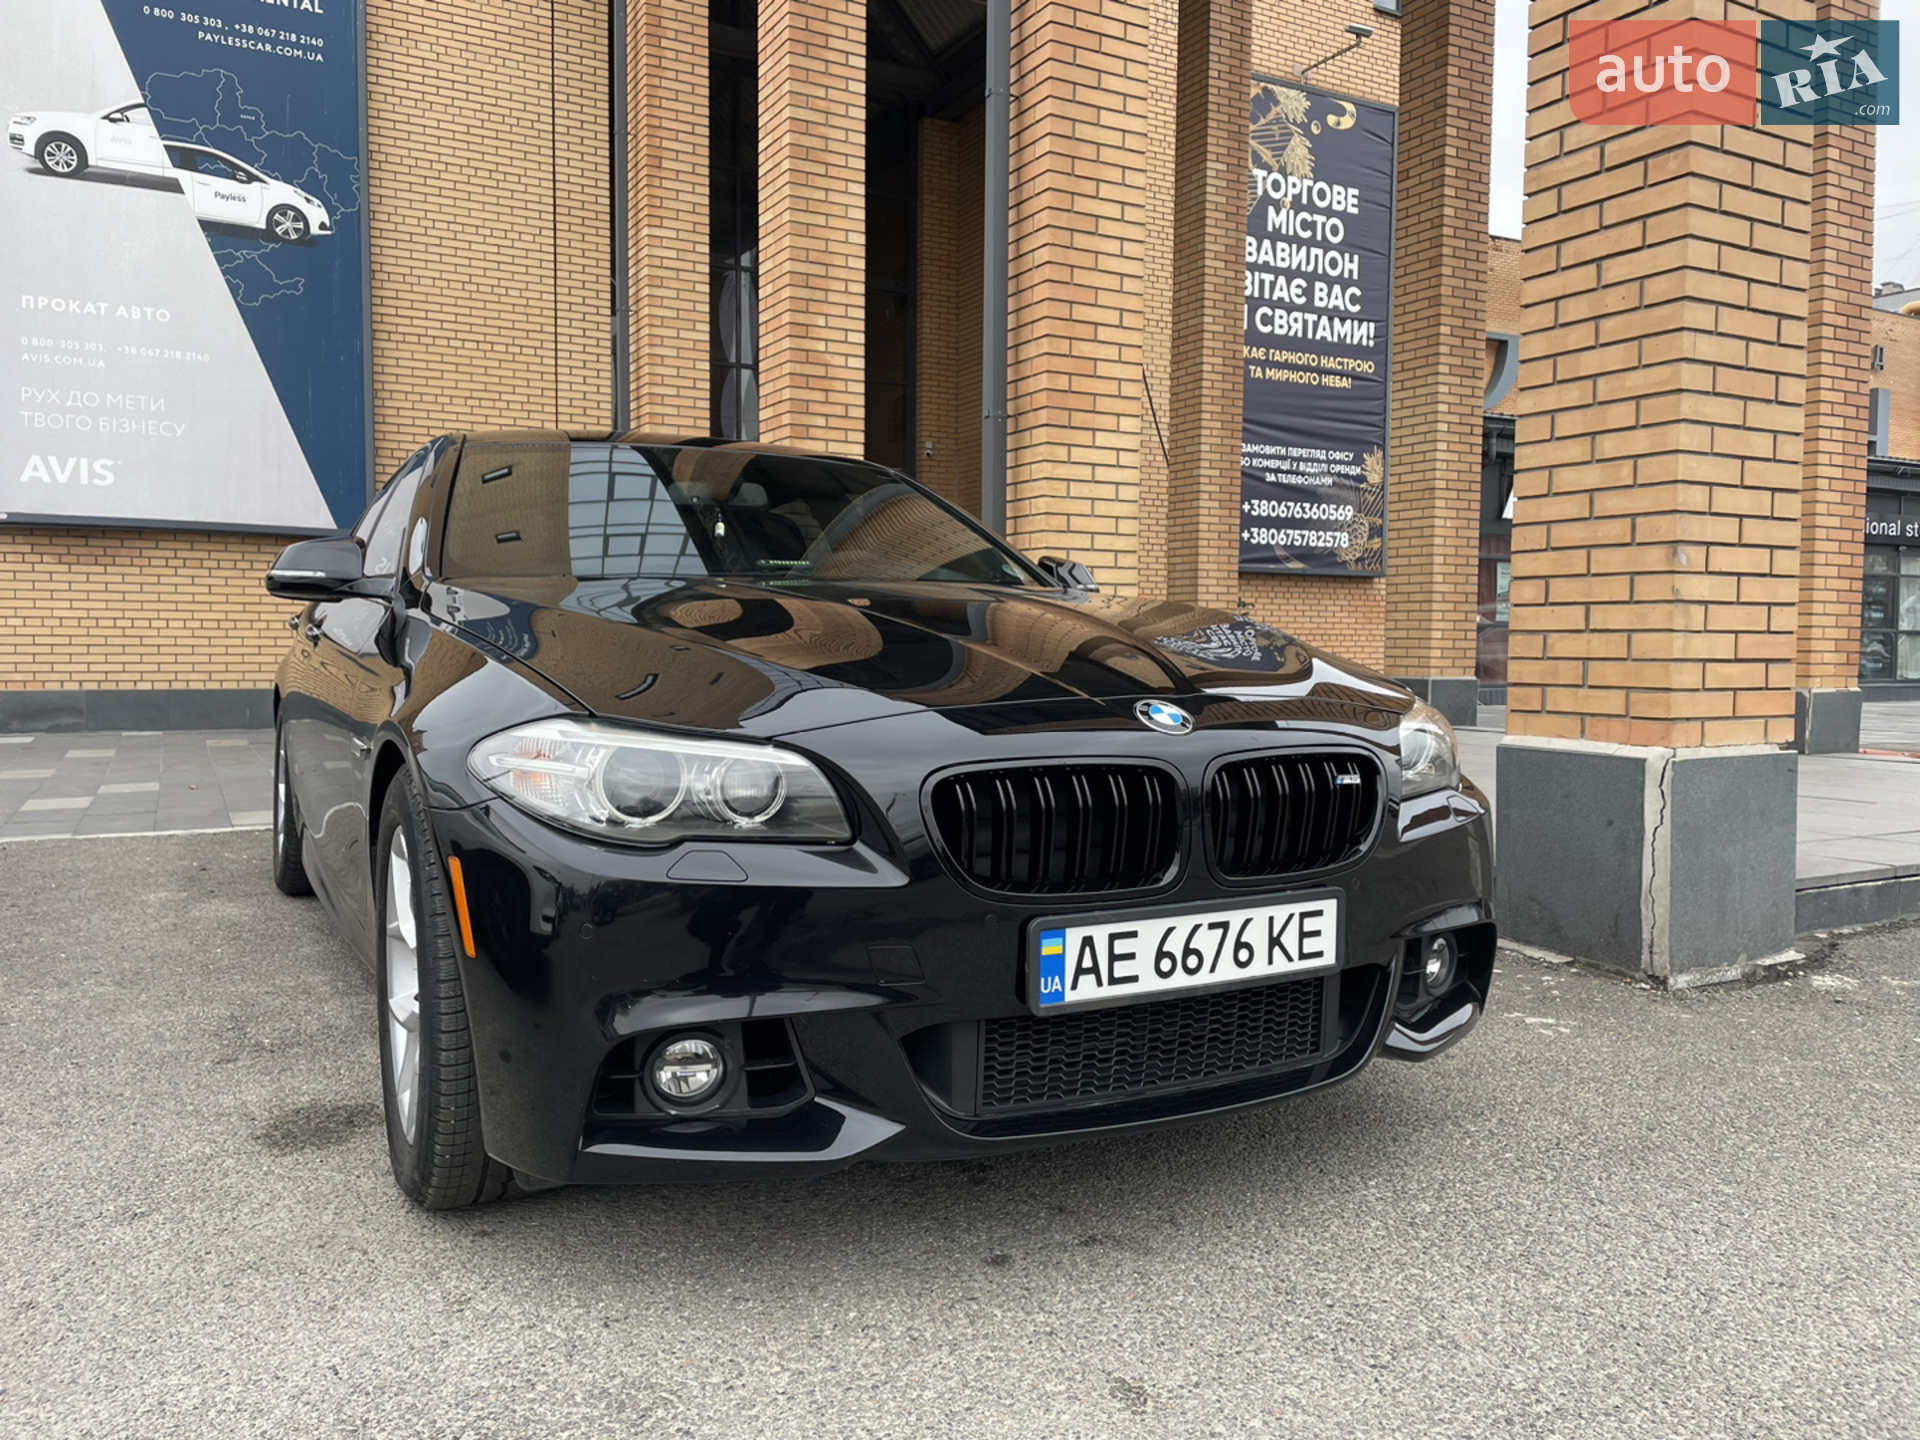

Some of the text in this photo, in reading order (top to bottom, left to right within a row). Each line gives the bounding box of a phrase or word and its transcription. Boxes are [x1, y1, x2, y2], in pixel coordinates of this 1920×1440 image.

[143, 5, 151, 15] 0
[153, 7, 175, 19] 800
[180, 12, 200, 24] 305
[234, 23, 254, 34] +38
[257, 27, 277, 38] 067
[279, 31, 297, 42] 218
[300, 35, 324, 48] 2140
[198, 30, 325, 63] PAYLESSCAR.COM.UA
[214, 190, 248, 204] Payless
[1253, 168, 1360, 215] ТОРГОВЕ
[1267, 205, 1345, 244] МІСТО
[1245, 235, 1360, 280] ВАВИЛОН
[22, 295, 171, 323] ПРОКАТ АВТО
[1314, 280, 1362, 313] ВАС
[1255, 305, 1376, 348] СВЯТАМИ!
[21, 336, 29, 347] 0
[32, 337, 53, 349] 800
[60, 339, 81, 351] 305
[116, 345, 138, 357] +38
[140, 347, 162, 359] 067
[164, 350, 182, 361] 218
[185, 351, 210, 363] 2140
[22, 353, 106, 369] AVIS.COM.UA
[1269, 348, 1319, 367] ГАРНОГО
[1320, 355, 1376, 374] НАСТРОЮ
[1249, 365, 1353, 389] ТА МИРНОГО НЕБА!
[21, 386, 165, 412] РУХ ДО МЕТИ
[20, 411, 186, 438] ТВОГО БІЗНЕСУ
[1328, 450, 1354, 461] ОФІСУ
[19, 455, 116, 487] AVIS
[1265, 472, 1333, 486] ЗА ТЕЛЕФОНАМИ
[1862, 517, 1920, 537] ional st
[1070, 909, 1324, 991] AE 6676 KE
[1041, 976, 1063, 994] UA
